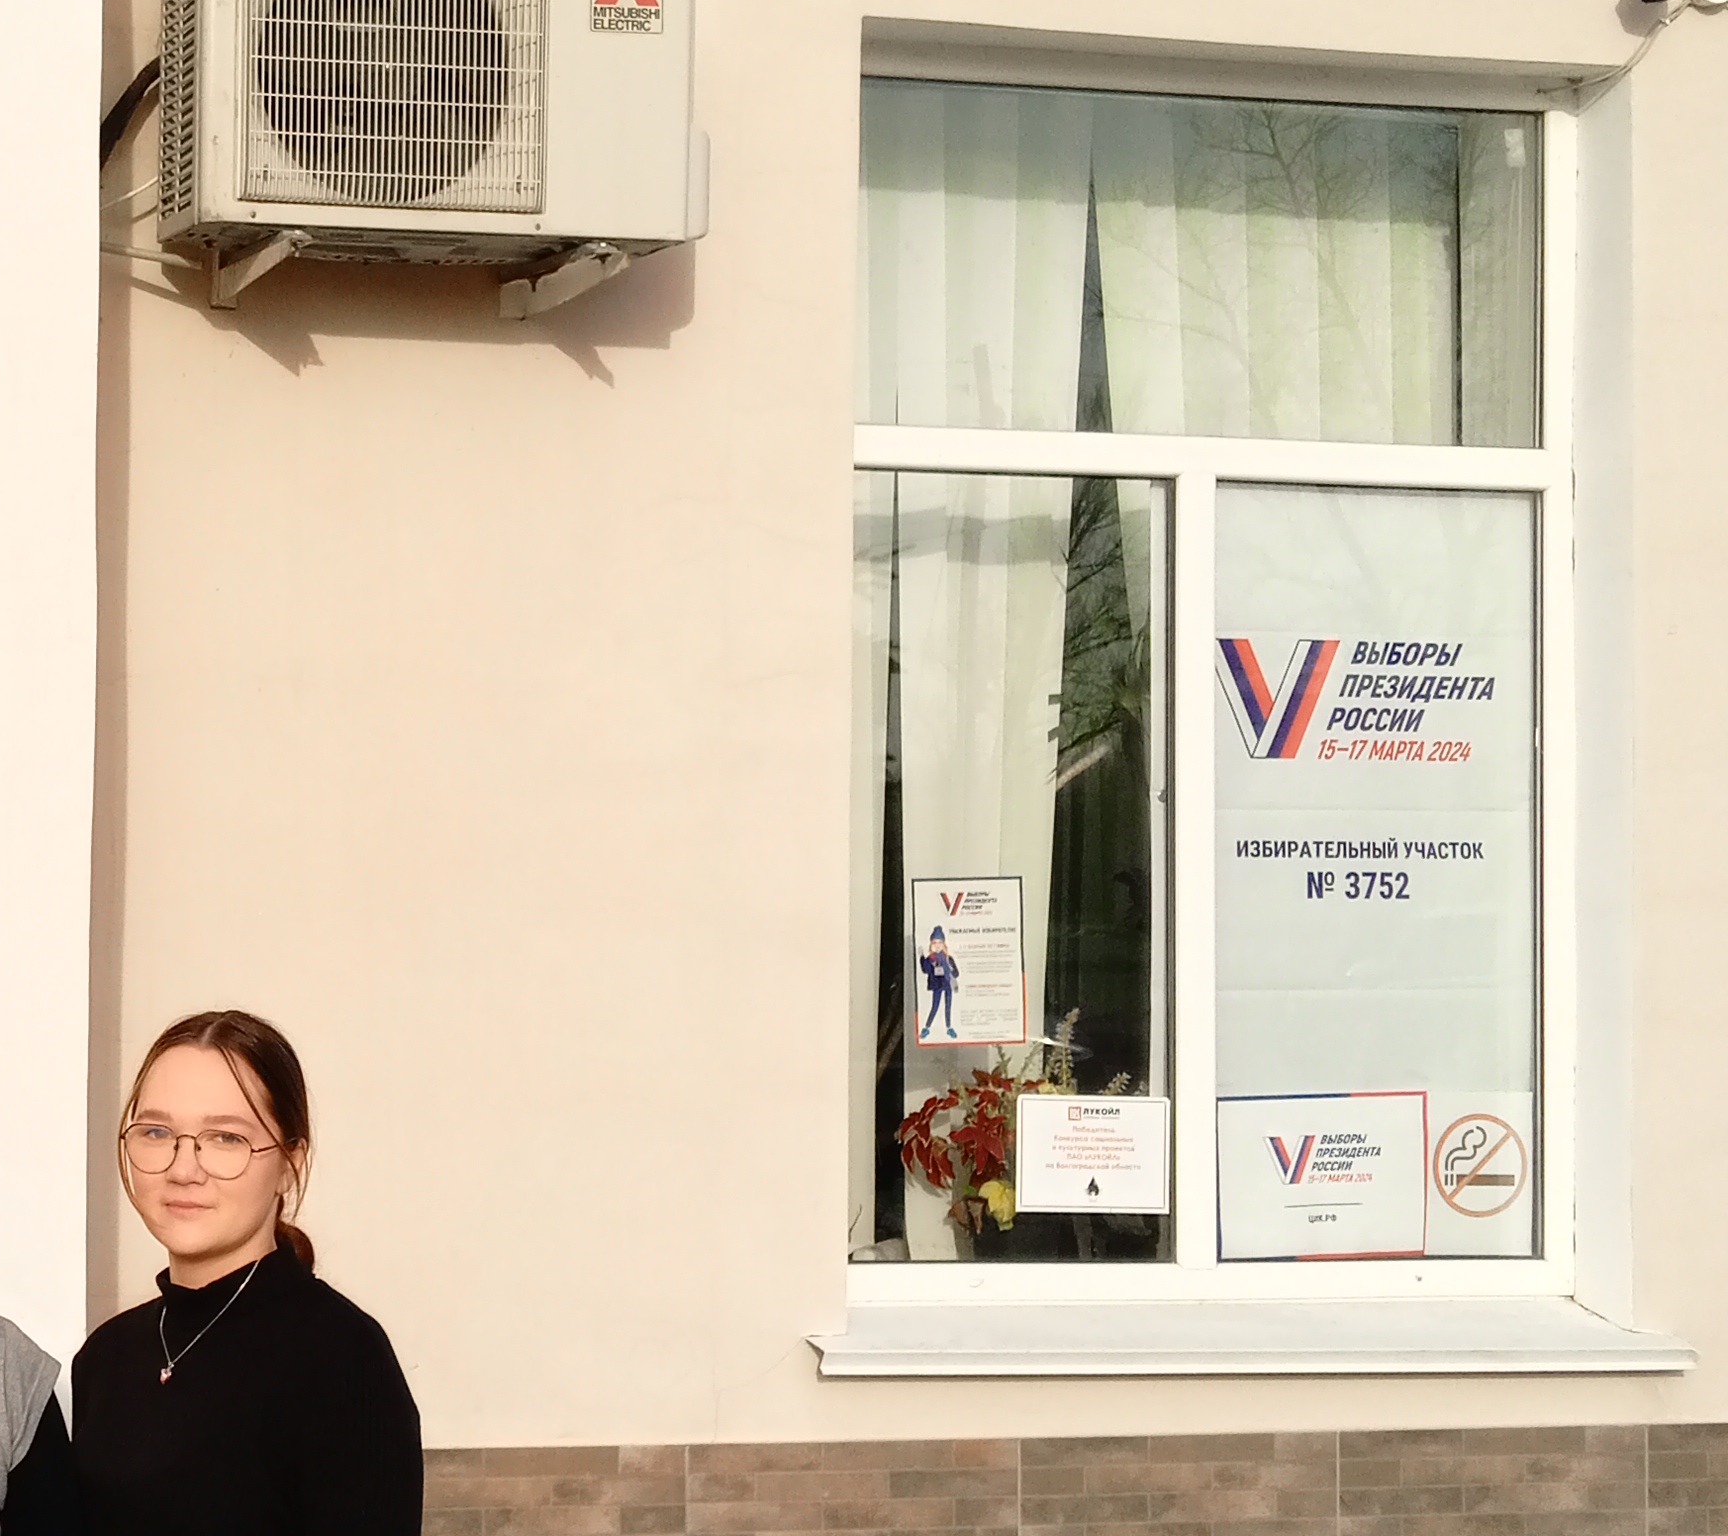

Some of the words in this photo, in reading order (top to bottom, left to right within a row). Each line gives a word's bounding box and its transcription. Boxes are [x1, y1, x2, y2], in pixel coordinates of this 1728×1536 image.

[593, 6, 660, 19] MITSUBISHI
[593, 19, 651, 31] ELECTRIC
[1351, 641, 1463, 667] ВЫБОРЫ
[1339, 674, 1495, 703] ПРЕЗИДЕНТА
[1326, 707, 1425, 732] РОССИИ
[1368, 740, 1423, 761] МАРТА
[1427, 741, 1472, 762] 2024
[1236, 838, 1398, 859] ИЗБИРАТЕЛЬНЫЙ
[1403, 841, 1484, 860] УЧАСТОК
[1307, 871, 1335, 899] №
[1345, 871, 1410, 900] 3752
[1083, 1107, 1120, 1116] ЛУКОЙЛ
[1320, 1133, 1367, 1145] ВЫБОРЫ
[1315, 1146, 1381, 1159] ПРЕЗИДЕНТА
[1311, 1160, 1353, 1171] РОССИИ
[1327, 1173, 1353, 1183] МАРТА
